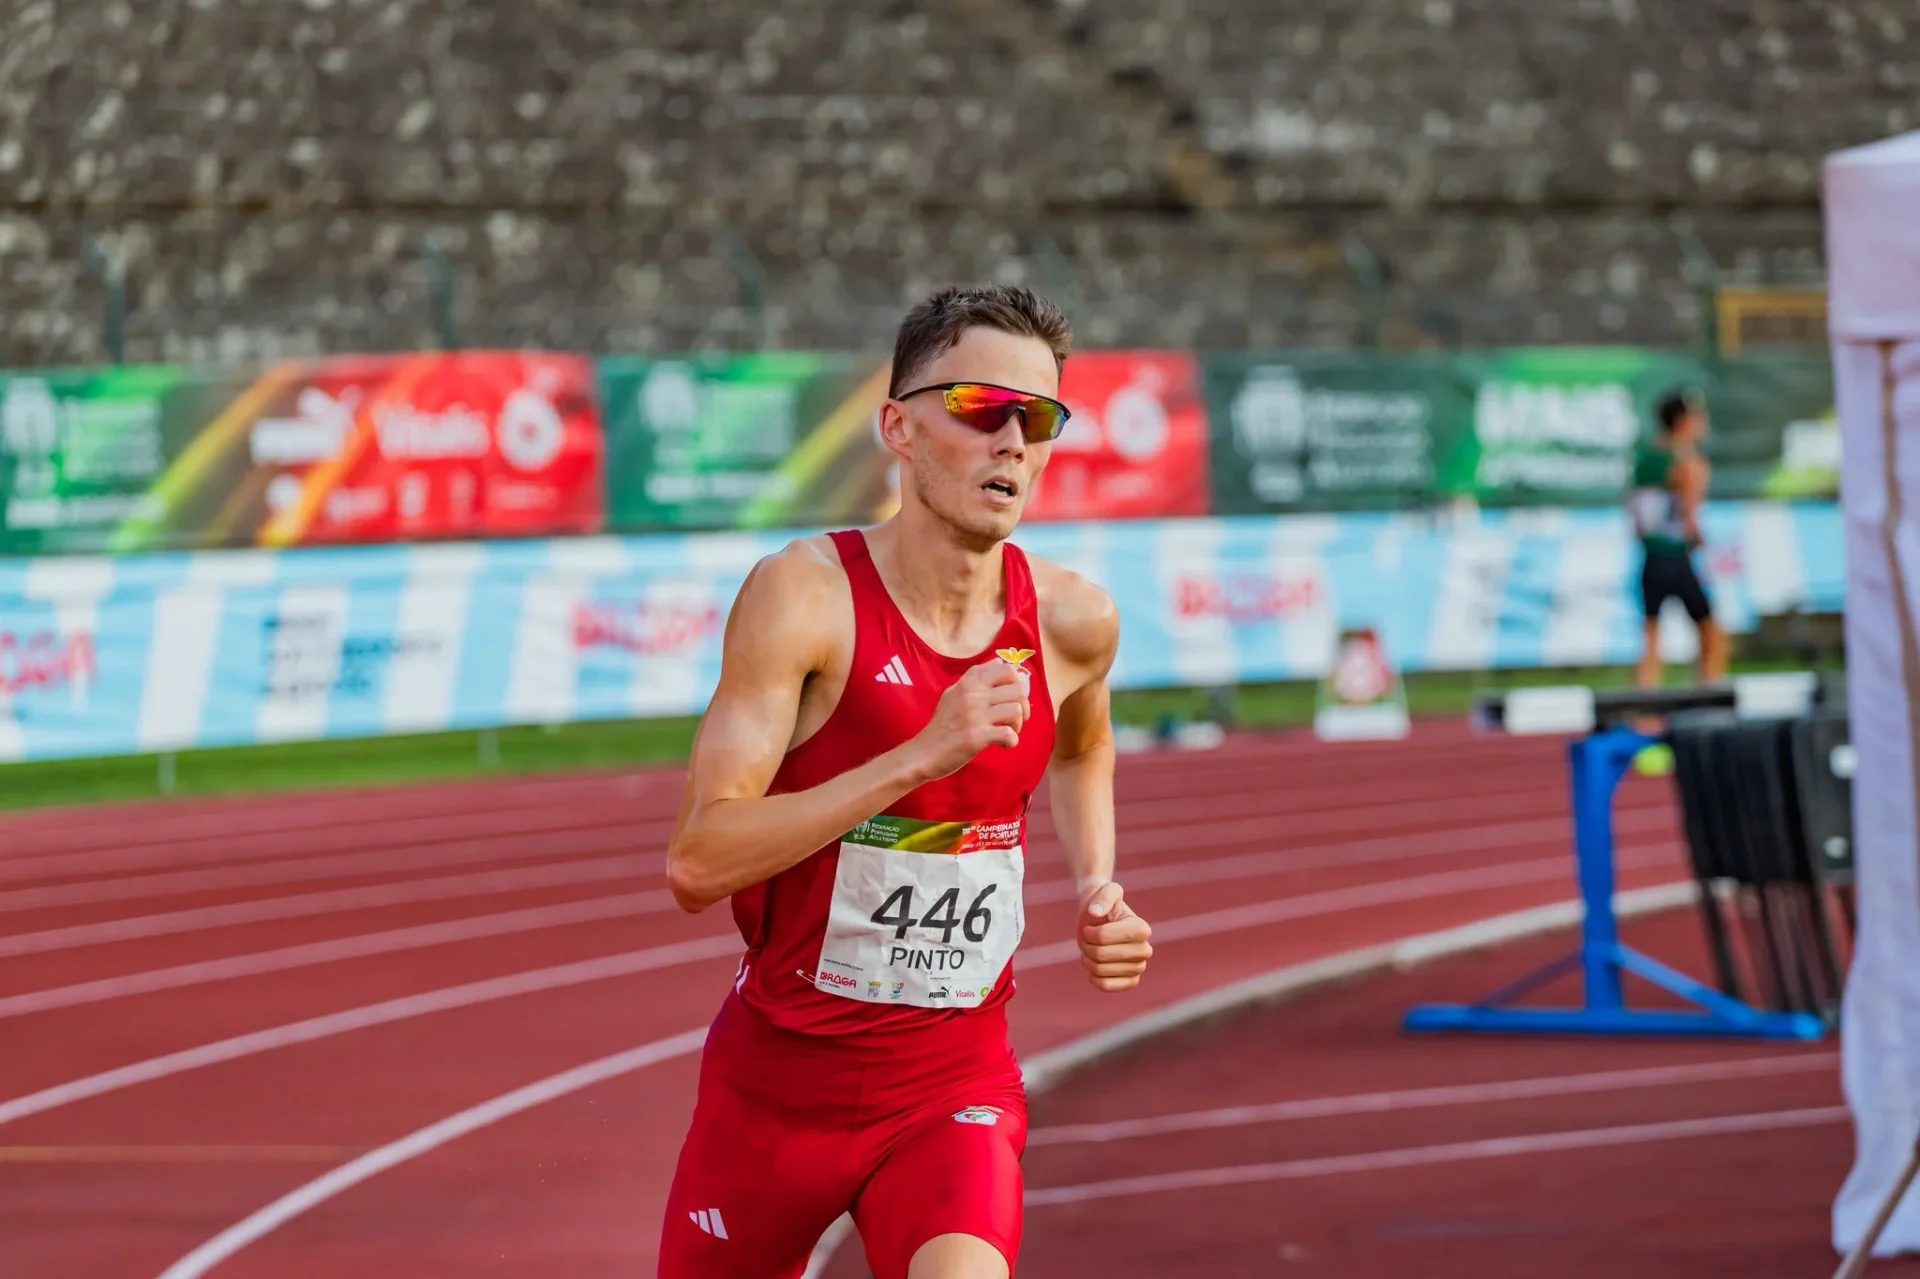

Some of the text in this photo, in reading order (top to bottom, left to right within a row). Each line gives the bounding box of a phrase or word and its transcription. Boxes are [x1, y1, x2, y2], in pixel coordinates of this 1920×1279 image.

[870, 884, 997, 943] 446
[889, 947, 965, 970] PINTO
[819, 971, 857, 988] BRAGA
[955, 990, 975, 998] Vitalis
